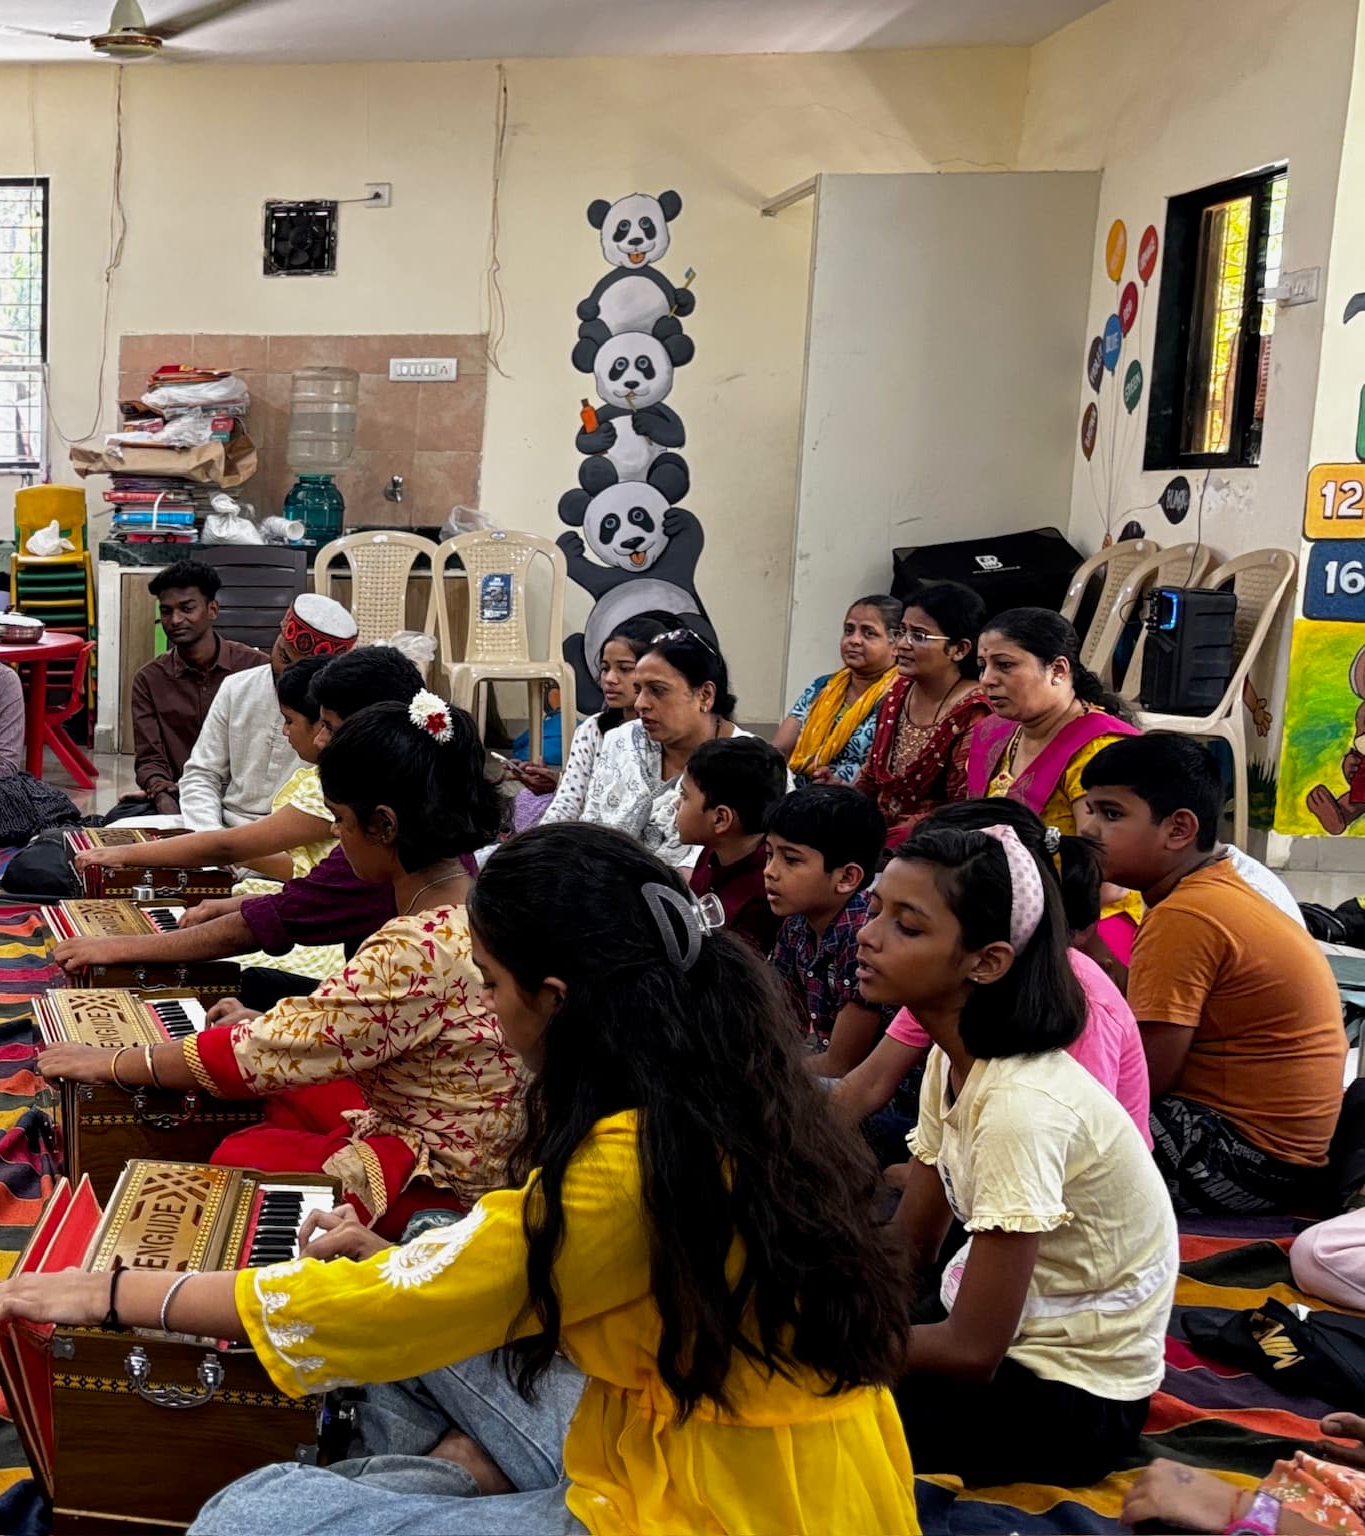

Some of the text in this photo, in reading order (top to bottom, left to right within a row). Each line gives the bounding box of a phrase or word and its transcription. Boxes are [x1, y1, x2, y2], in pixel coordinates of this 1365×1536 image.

[1320, 480, 1365, 520] 12
[1324, 560, 1365, 596] 16
[87, 1012, 124, 1050] ENGUDE
[132, 1203, 187, 1272] ENGUDE
